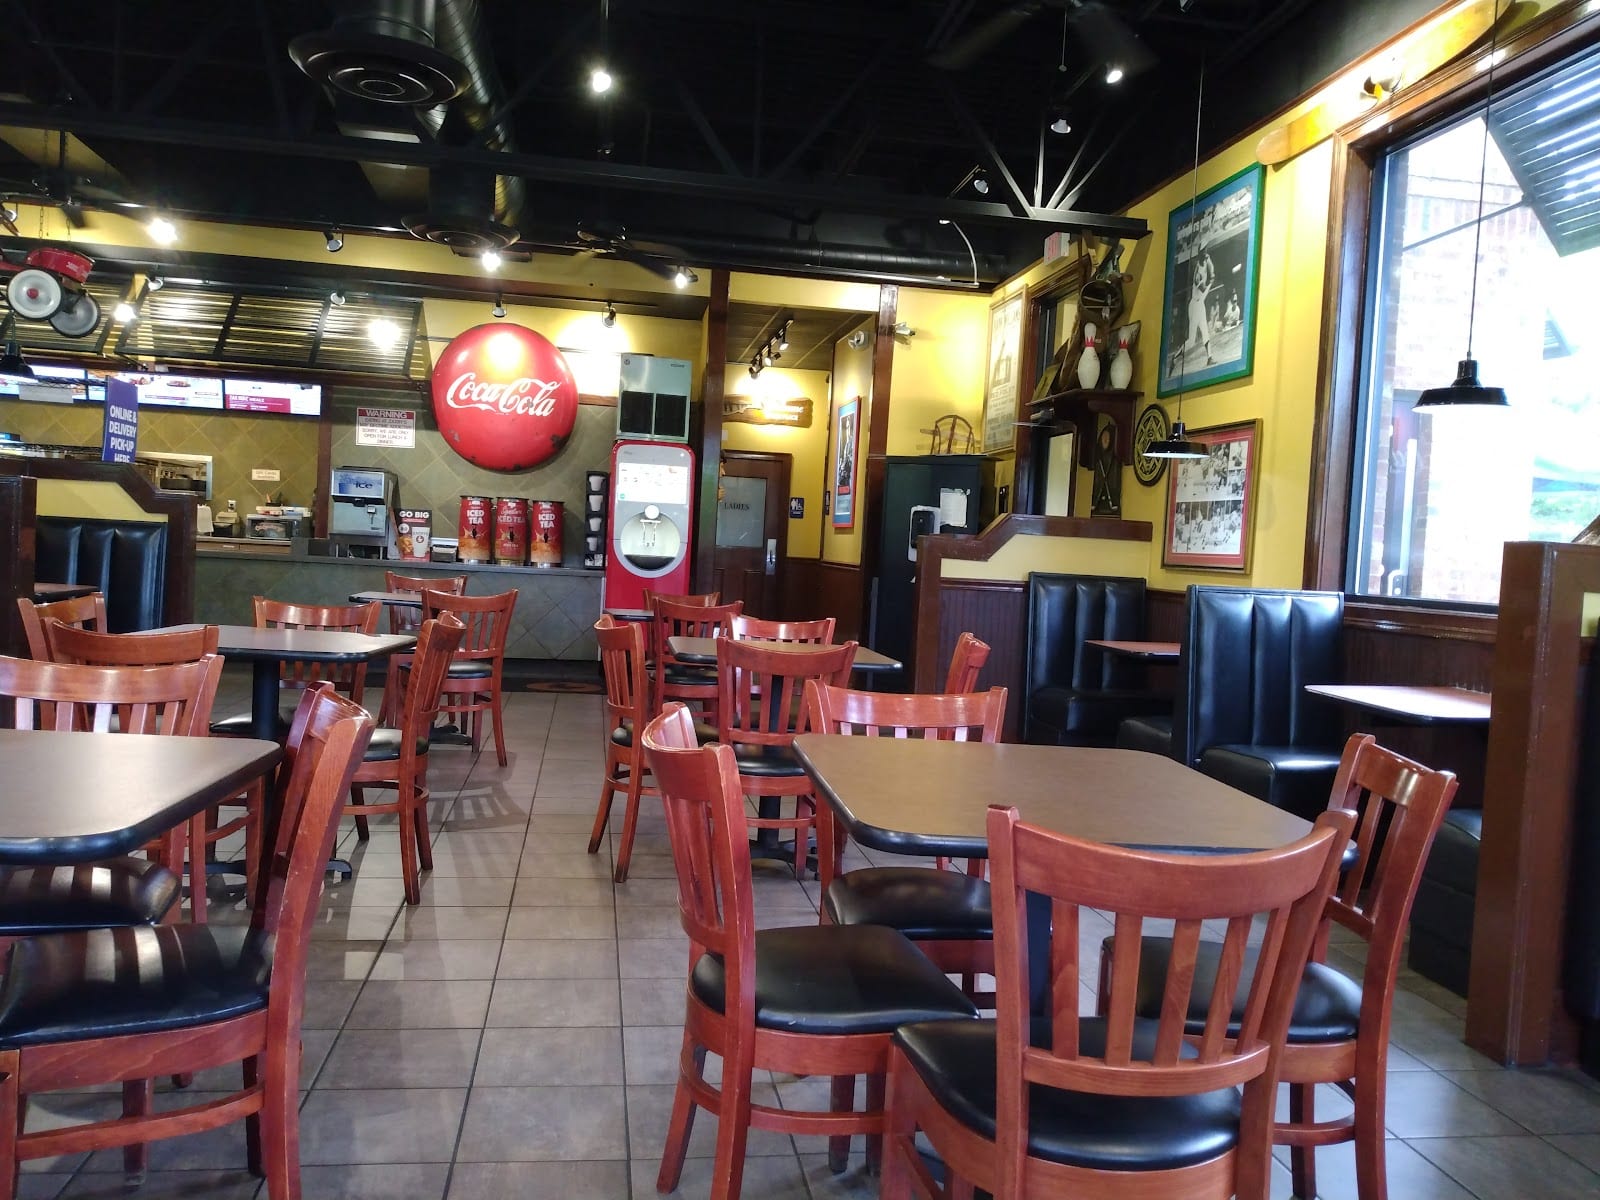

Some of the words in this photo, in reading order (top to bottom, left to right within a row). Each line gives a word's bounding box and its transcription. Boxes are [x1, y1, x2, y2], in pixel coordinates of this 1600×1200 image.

[109, 405, 132, 421] ONLINE
[132, 412, 137, 423] &
[366, 409, 408, 418] WARNING
[108, 421, 137, 438] DELIVERY
[110, 437, 135, 452] PICK-UP
[724, 502, 751, 511] LADIES
[399, 510, 413, 518] GO
[414, 511, 430, 519] BIG
[466, 509, 485, 517] ICED
[538, 513, 556, 521] ICED
[468, 517, 484, 525] TEA
[540, 520, 555, 529] TEA
